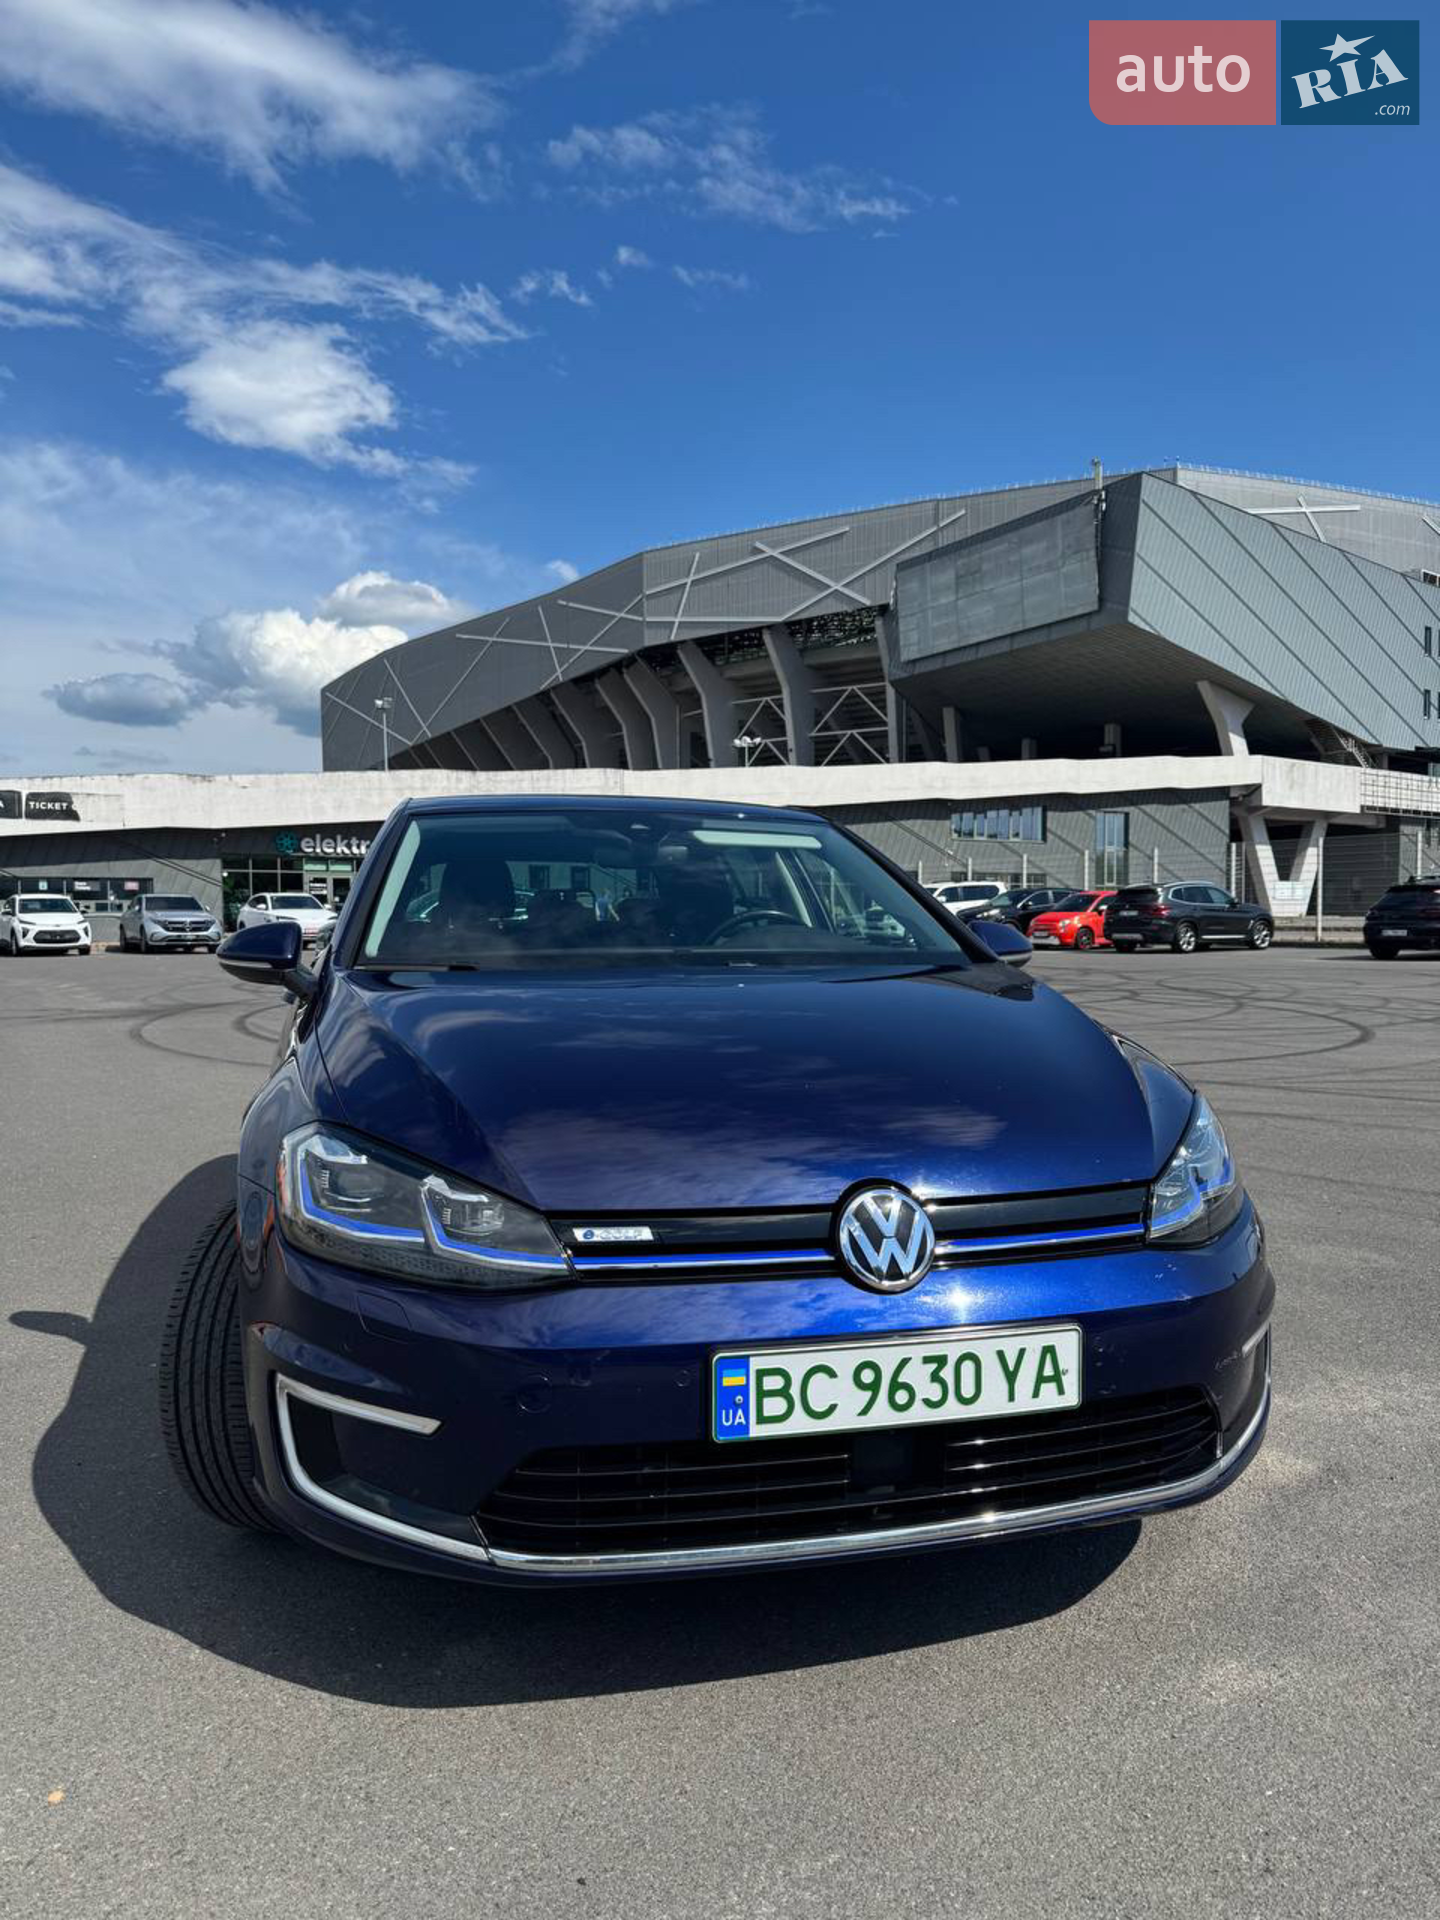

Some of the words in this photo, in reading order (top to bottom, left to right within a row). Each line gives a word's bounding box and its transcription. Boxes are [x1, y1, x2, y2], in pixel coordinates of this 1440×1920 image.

[28, 801, 68, 810] TICKET
[755, 1364, 839, 1426] BC
[852, 1351, 982, 1417] 9630
[996, 1344, 1066, 1403] YA
[722, 1409, 747, 1427] UA
